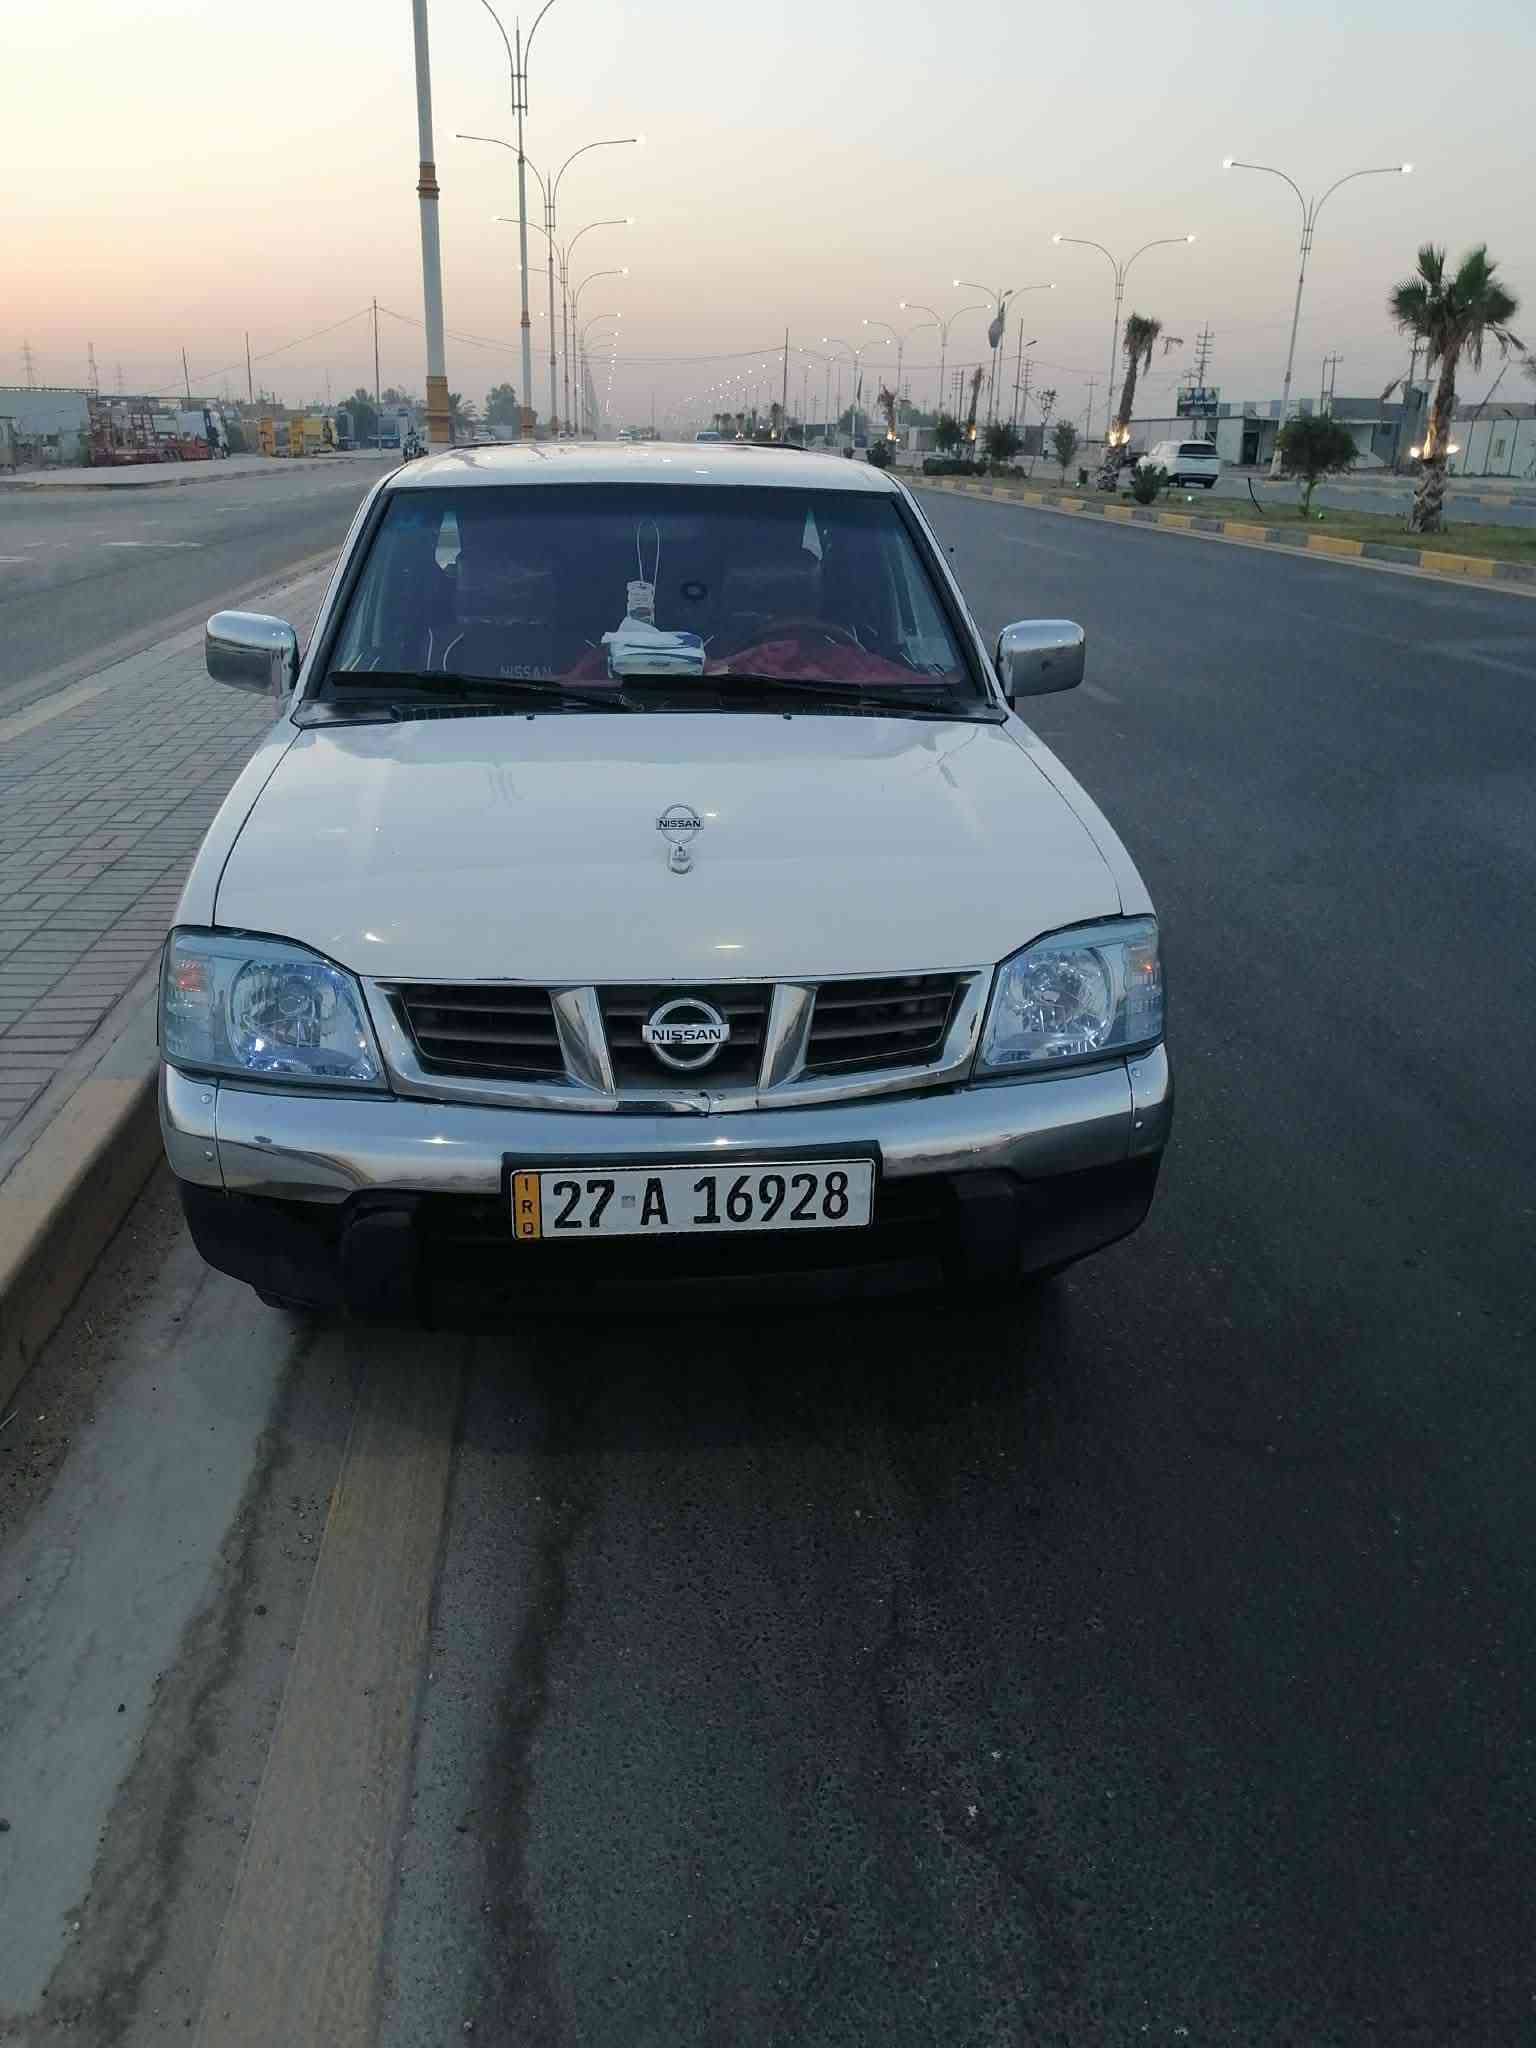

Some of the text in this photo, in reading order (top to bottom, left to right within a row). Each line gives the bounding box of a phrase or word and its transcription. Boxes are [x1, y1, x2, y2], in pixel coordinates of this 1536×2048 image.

[658, 819, 701, 829] NISSAN
[651, 1028, 721, 1041] NISSAN
[553, 1171, 849, 1229] 27 A 16928
